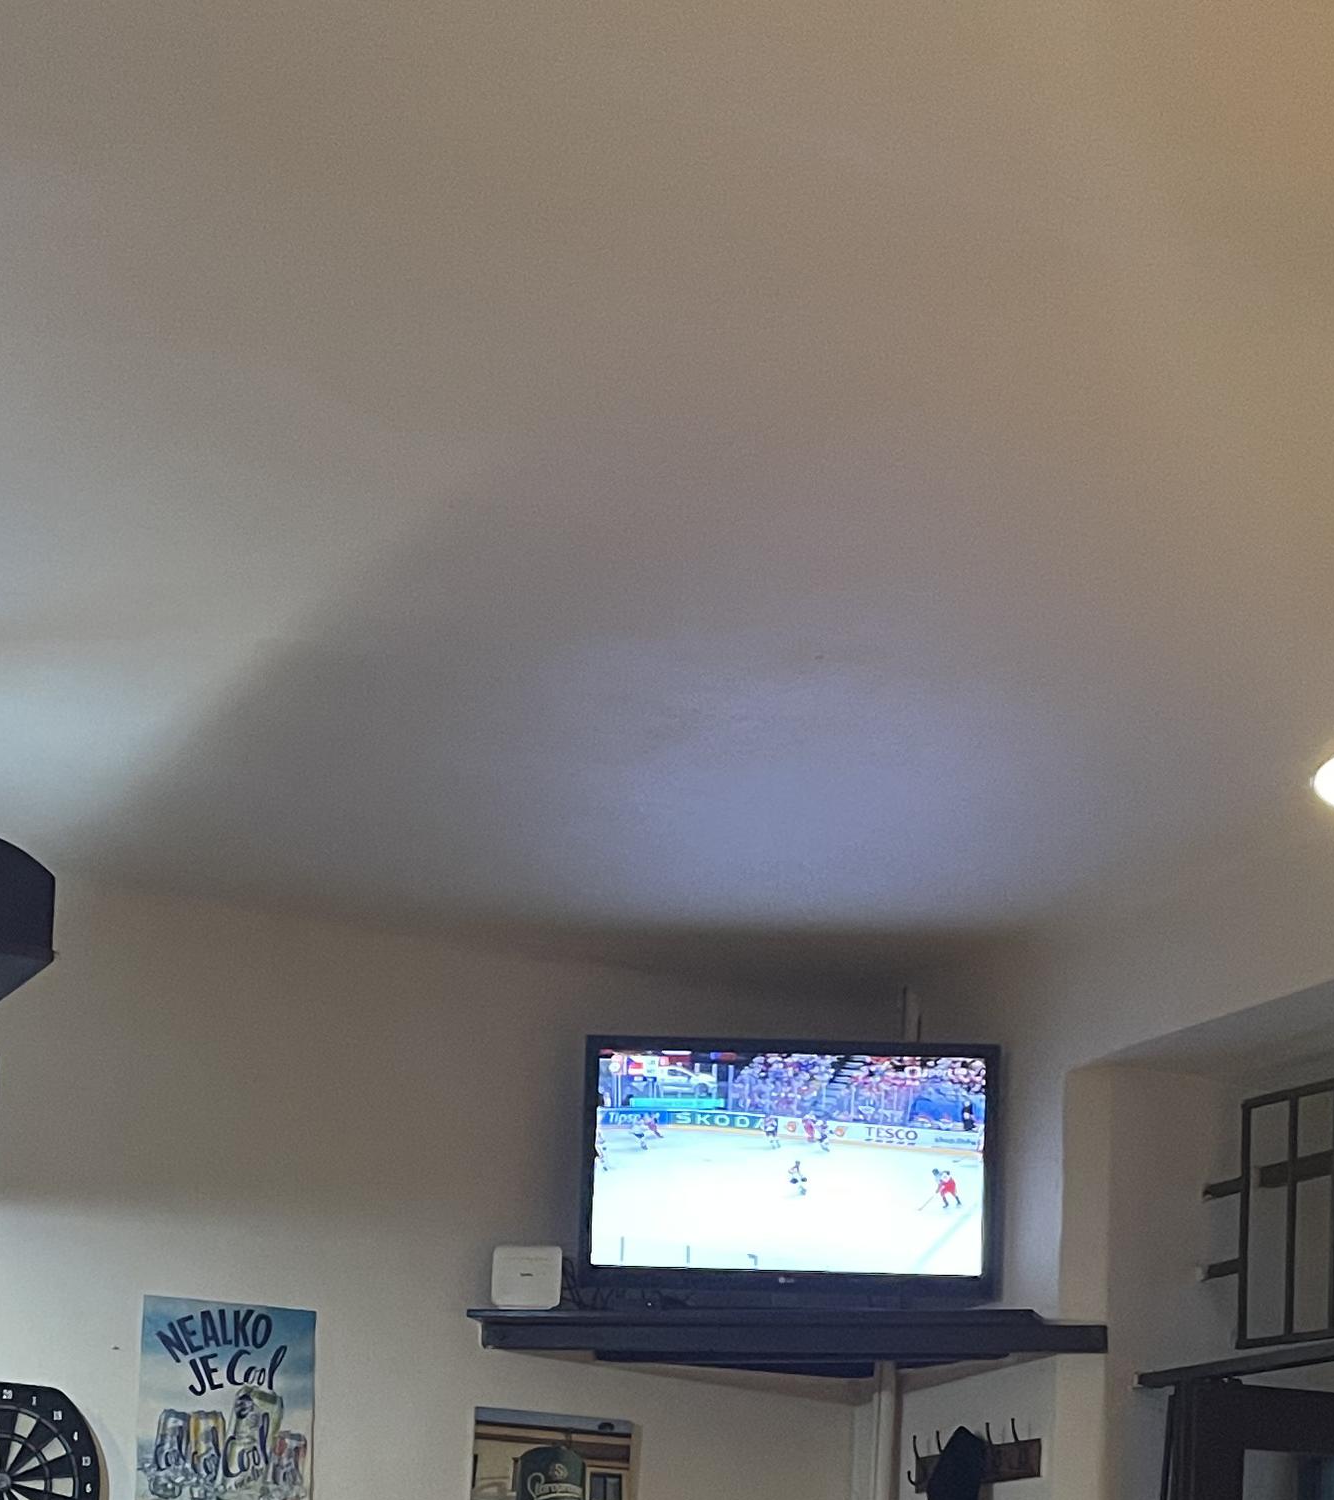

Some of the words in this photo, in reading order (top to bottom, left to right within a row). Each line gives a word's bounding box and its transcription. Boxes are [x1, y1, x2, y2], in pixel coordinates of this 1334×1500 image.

[865, 1126, 918, 1141] TESCO
[156, 1309, 272, 1363] NEALKO
[188, 1353, 223, 1396] JE
[226, 1345, 287, 1390] Cool
